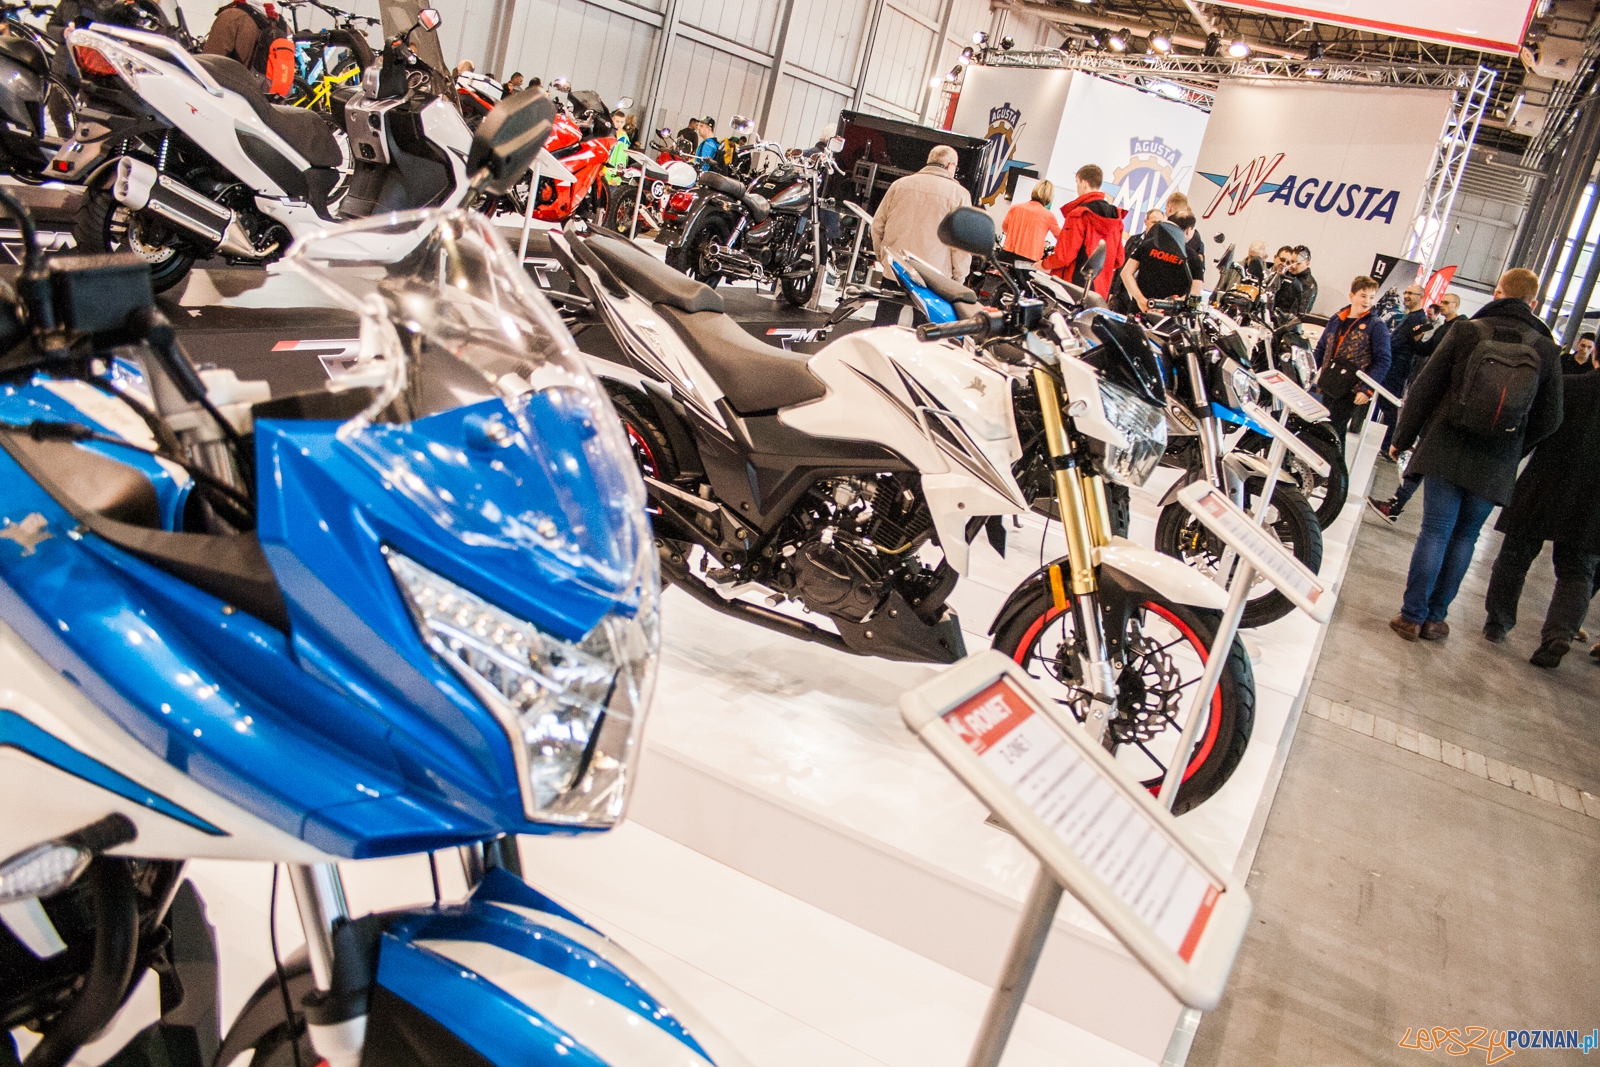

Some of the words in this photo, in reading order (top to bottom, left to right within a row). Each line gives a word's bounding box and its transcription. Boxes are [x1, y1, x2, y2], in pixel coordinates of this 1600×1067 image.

[990, 109, 1017, 125] AGUSTA
[1134, 141, 1176, 165] AGUSTA
[1202, 153, 1286, 219] MV
[1267, 174, 1400, 225] AGUSTA
[963, 693, 1013, 737] ROMET
